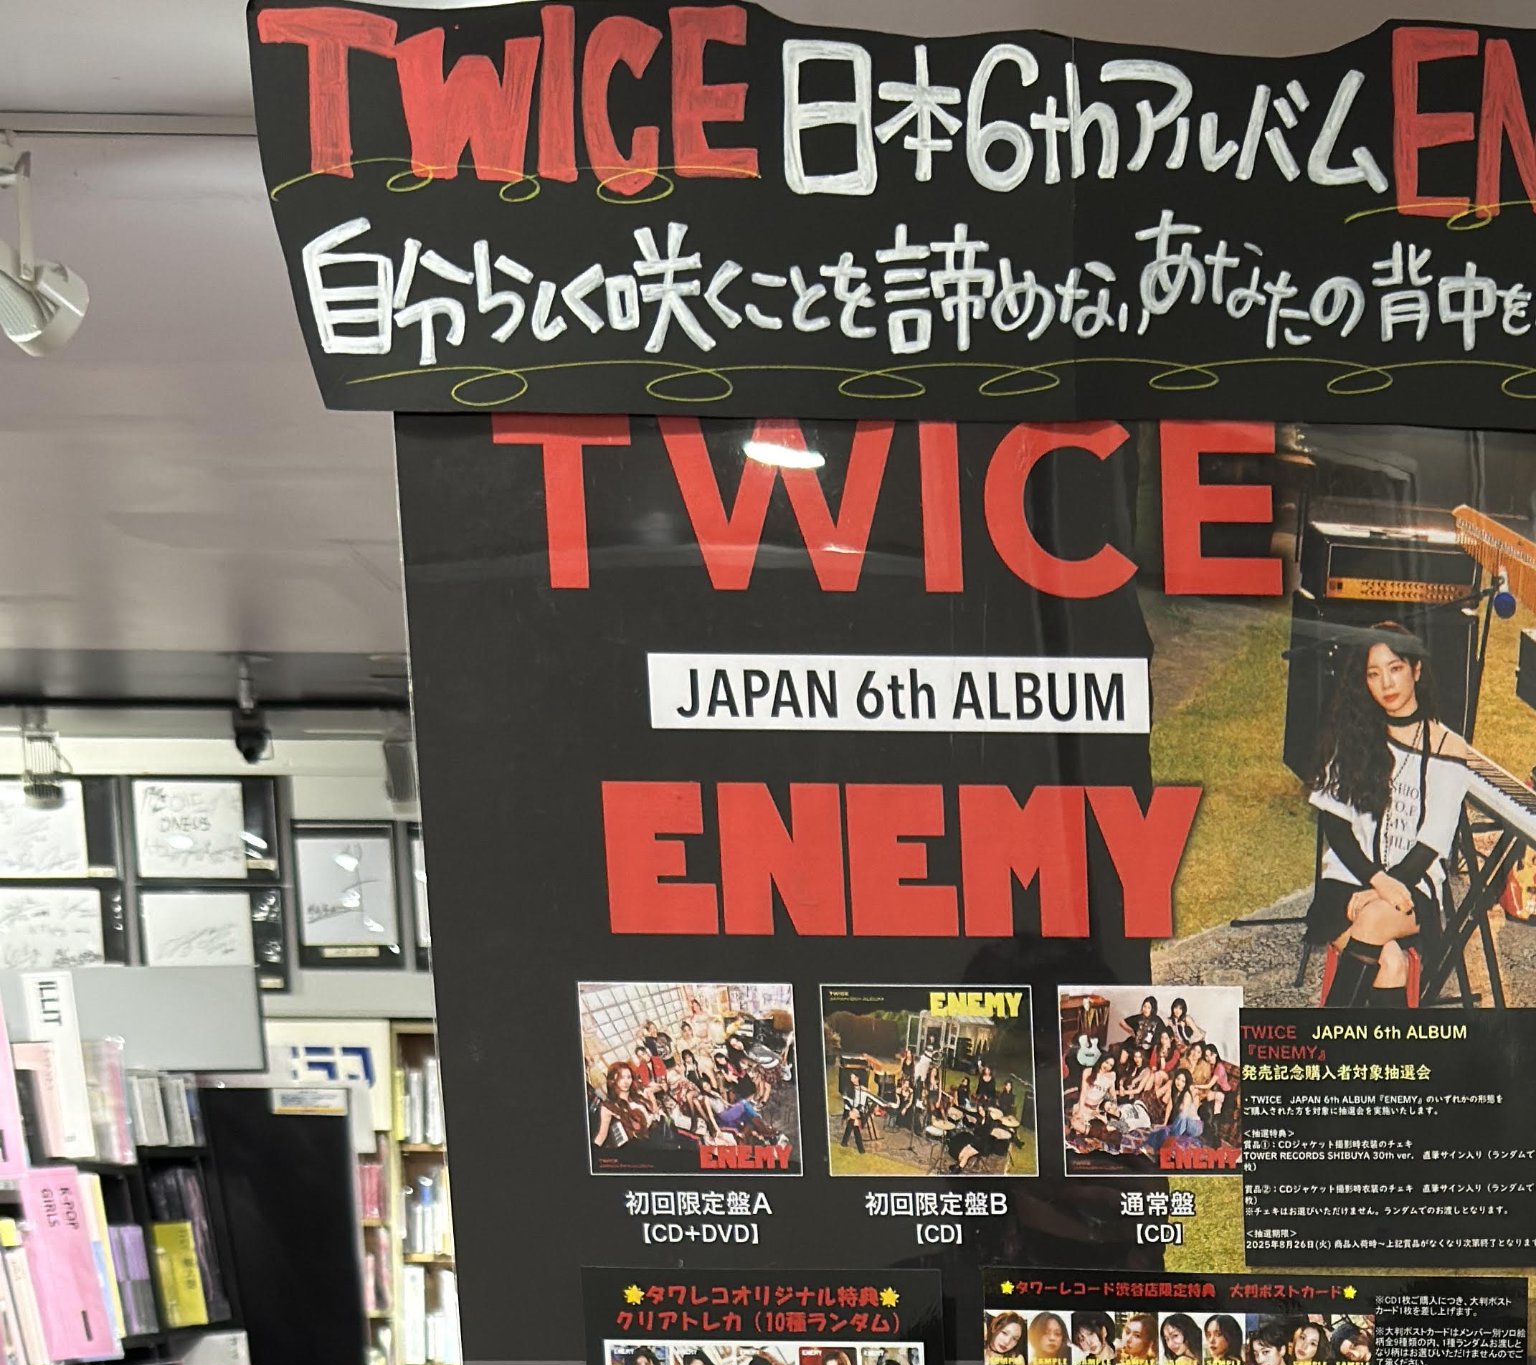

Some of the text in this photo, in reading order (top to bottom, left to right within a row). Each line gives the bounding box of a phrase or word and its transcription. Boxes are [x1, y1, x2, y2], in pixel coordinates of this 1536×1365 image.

[259, 4, 760, 197] TWICE
[492, 412, 1284, 598] TWICE
[677, 669, 1125, 722] JAPAN 6th ALBUM
[602, 781, 1202, 938] ENEMY
[38, 980, 64, 1026] ILLIT
[930, 991, 1022, 1017] ENEMY
[1241, 1025, 1467, 1040] TWICE JAPAN 6th ALBUM
[1242, 1064, 1431, 1080] 発売記念購入者対象抽選会
[1290, 1095, 1339, 1104] JAPAN 6th
[701, 1144, 790, 1169] ENEMY
[1160, 1145, 1242, 1170] ENEMY
[1244, 1152, 1277, 1160] TOWER
[1280, 1152, 1325, 1160] RECORDS
[1327, 1152, 1369, 1160] SHIBUYA
[1373, 1151, 1394, 1160] 30th
[39, 1188, 59, 1228] GIRLS
[58, 1184, 80, 1231] K-POP
[625, 1191, 772, 1215] 初回限定盤A
[865, 1192, 1007, 1216] 初回限定盤B
[1120, 1192, 1195, 1216] 通常盤
[645, 1285, 880, 1308] タワレコオリジナル特典
[1015, 1282, 1343, 1300] タワーレコード渋谷店限定特典 大判ポストカード
